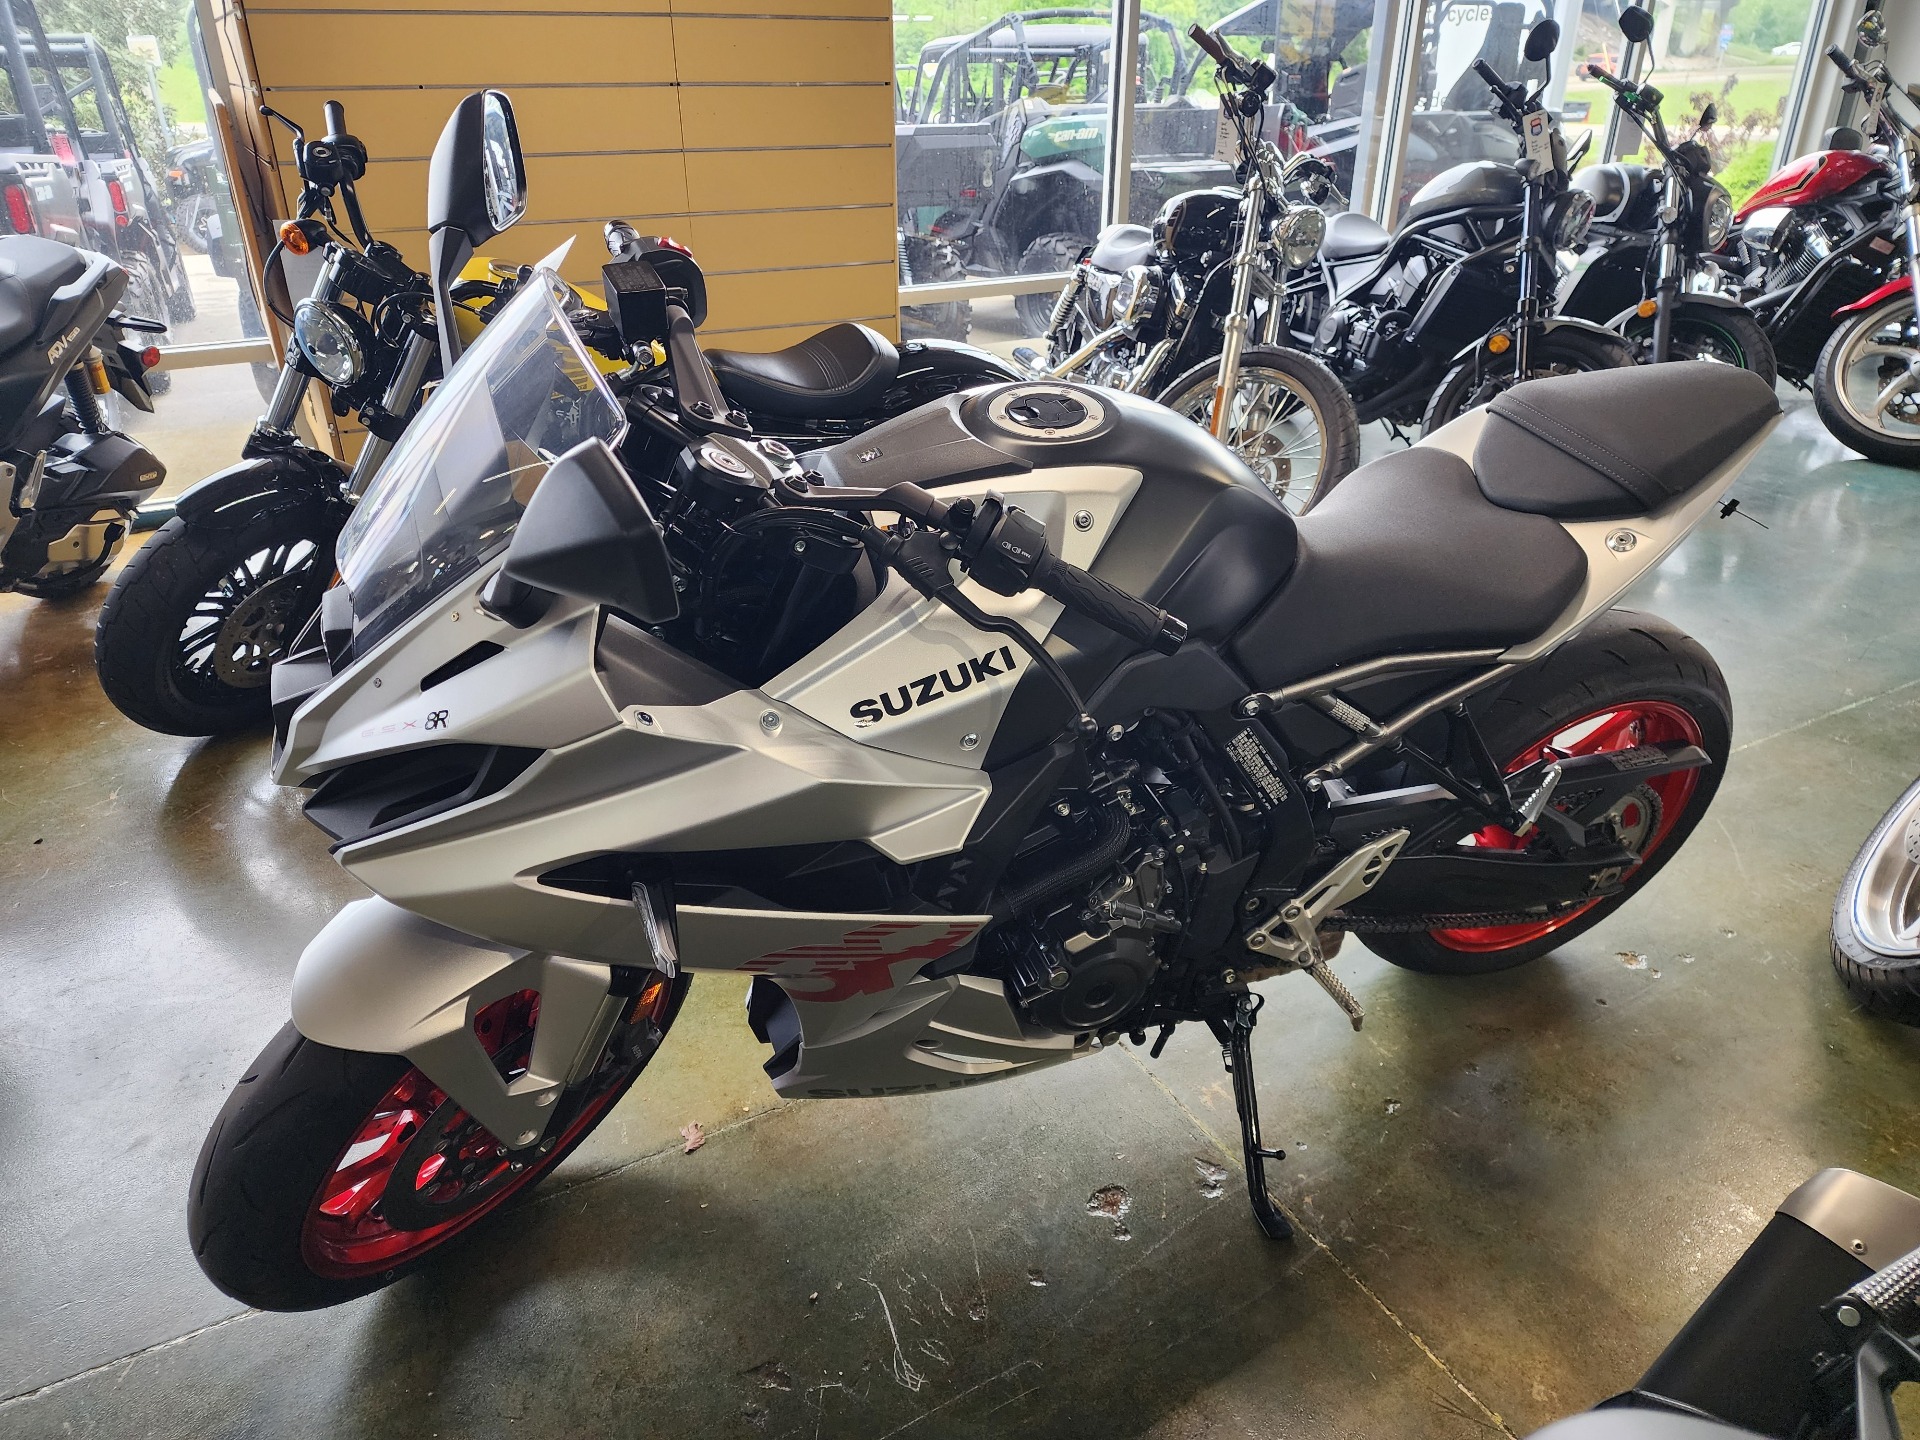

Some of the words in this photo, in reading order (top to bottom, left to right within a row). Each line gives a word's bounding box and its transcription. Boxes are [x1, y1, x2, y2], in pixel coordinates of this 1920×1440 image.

[47, 334, 68, 365] ADV
[849, 645, 1017, 728] SUZUKI
[424, 709, 449, 731] 8R
